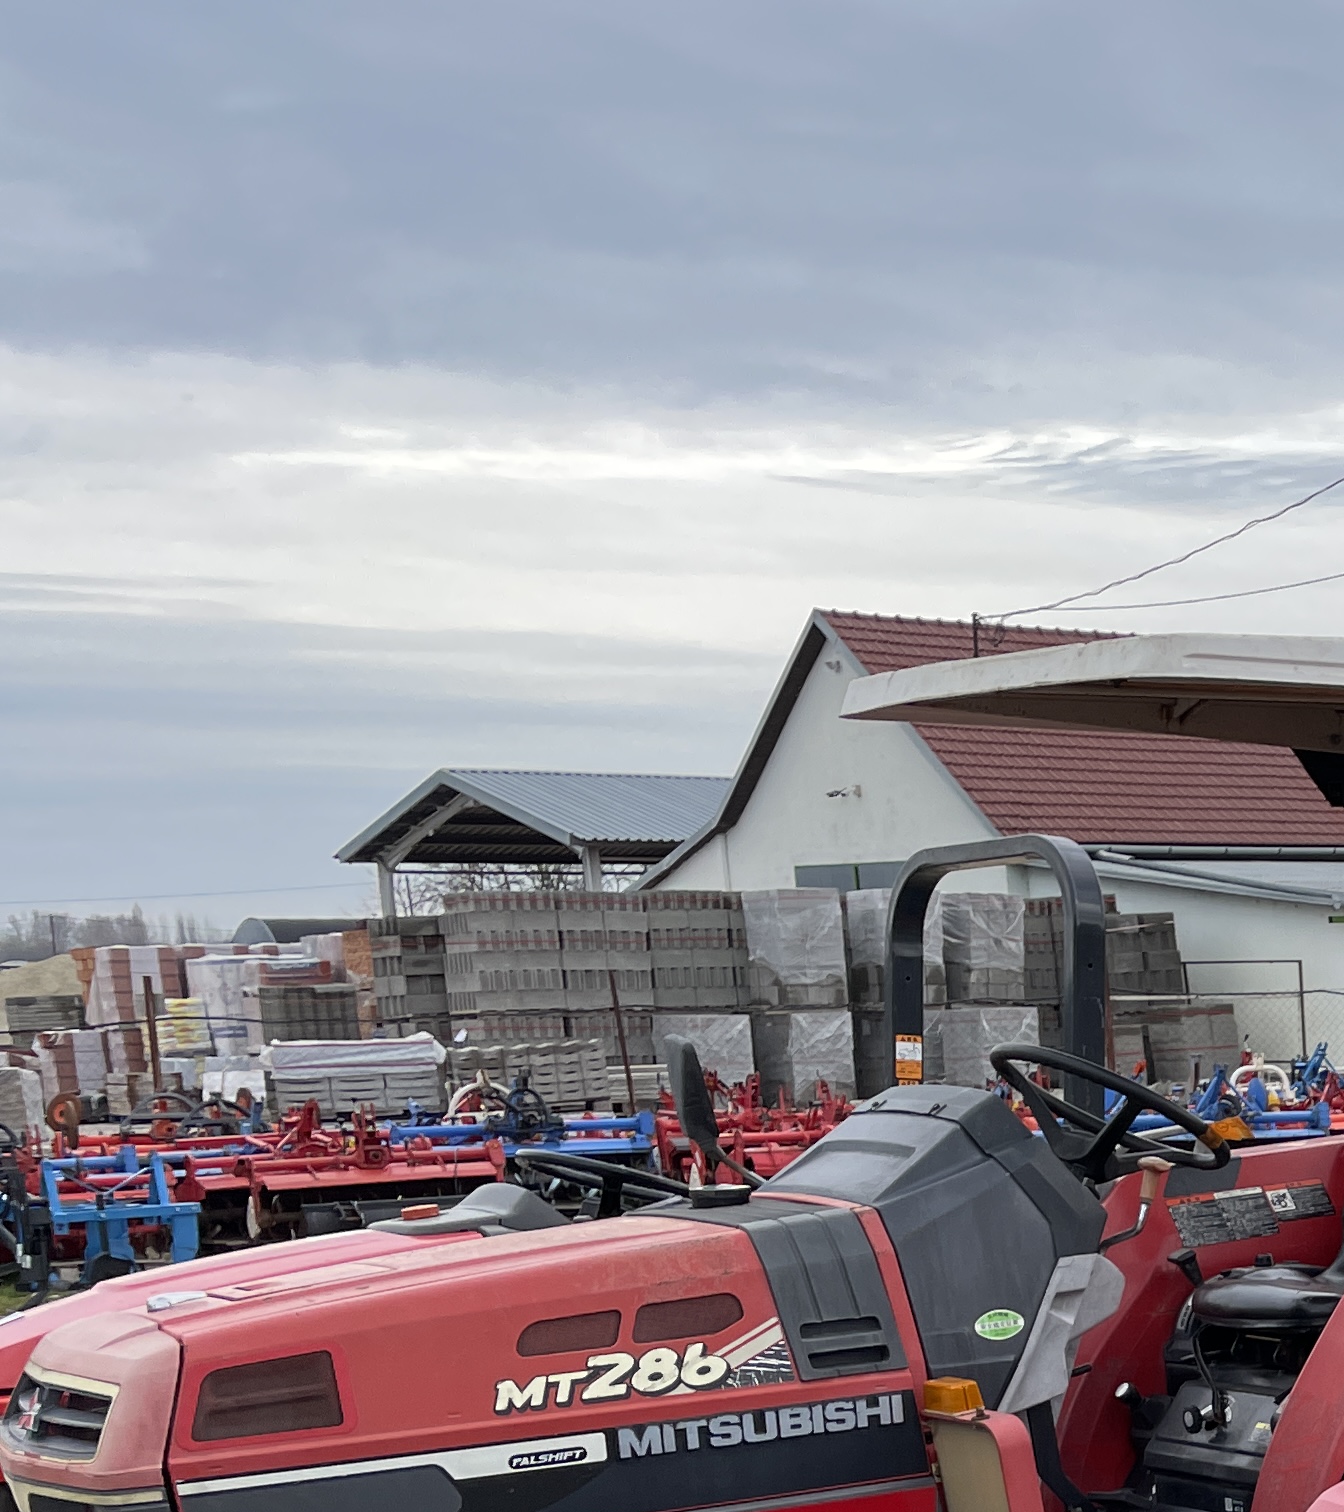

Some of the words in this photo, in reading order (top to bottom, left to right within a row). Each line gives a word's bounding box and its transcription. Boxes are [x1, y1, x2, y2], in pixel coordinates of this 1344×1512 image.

[495, 1343, 731, 1414] MT286
[511, 1449, 584, 1467] PALSHIFT
[617, 1393, 904, 1460] MITSUBISHI
